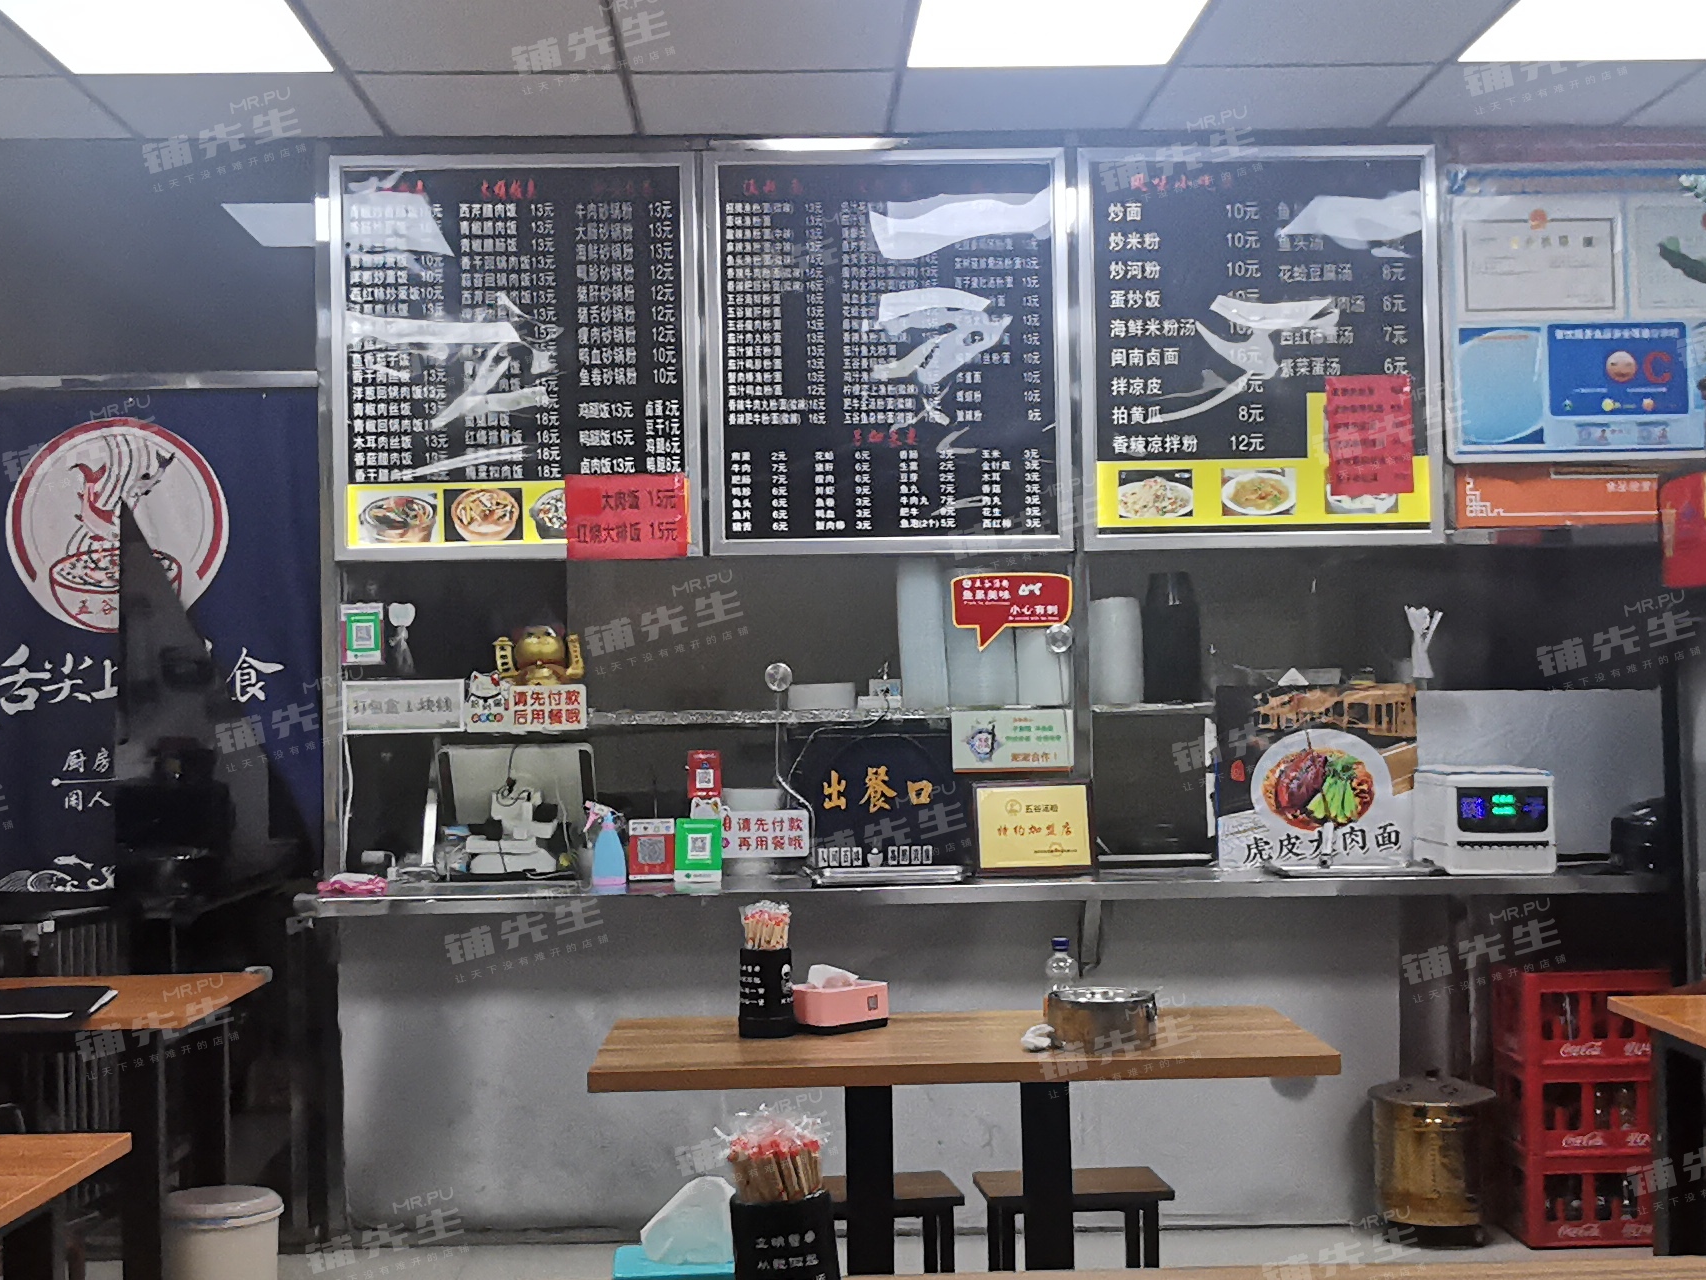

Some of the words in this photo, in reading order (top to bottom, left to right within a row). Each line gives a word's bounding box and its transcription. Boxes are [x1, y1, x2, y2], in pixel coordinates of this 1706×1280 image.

[531, 203, 555, 217] 13元
[649, 201, 673, 218] 13元
[1108, 203, 1142, 221] 炒面
[1226, 202, 1259, 220] 10元
[531, 221, 555, 234] 13元
[649, 221, 673, 238] 13元
[532, 238, 556, 252] 13元
[1109, 232, 1160, 250] 炒米粉
[1226, 231, 1260, 248] 10元
[650, 242, 674, 259] 13元
[650, 263, 674, 280] 12元
[1109, 261, 1161, 279] 炒河粉
[1227, 260, 1261, 277] 10元
[1382, 263, 1406, 281] 8元
[651, 284, 675, 301] 12元
[1109, 290, 1161, 308] 蛋炒饭
[652, 305, 675, 321] 12元
[652, 326, 676, 342] 12元
[1110, 319, 1195, 337] 海鲜米粉汤
[1383, 325, 1408, 344] 7元
[653, 347, 677, 363] 10元
[1110, 348, 1179, 367] 闽南卤面
[1280, 358, 1340, 377] 紫菜蛋汤
[1385, 357, 1409, 374] 6元
[654, 368, 678, 384] 10元
[1111, 377, 1162, 396] 拌凉皮
[1112, 406, 1163, 425] 拍黄瓜
[1238, 405, 1265, 422] 8元
[1112, 435, 1198, 453] 香辣凉拌粉
[1230, 434, 1265, 451] 12元
[1024, 449, 1040, 458] 3元
[1024, 461, 1040, 470] 3元
[1025, 473, 1040, 481] 3元
[1025, 484, 1040, 493] 3元
[647, 490, 678, 509] 15元
[1025, 496, 1041, 505] 3元
[1025, 507, 1041, 516] 3元
[649, 522, 678, 541] 15元
[1026, 519, 1041, 528] 3元
[1010, 605, 1058, 615] 小心有刺
[513, 690, 581, 707] 请先付款
[513, 709, 581, 725] 后用餐哦
[822, 765, 933, 813] 出餐口
[738, 817, 803, 832] 请先付款
[738, 836, 803, 850] 再用餐哦
